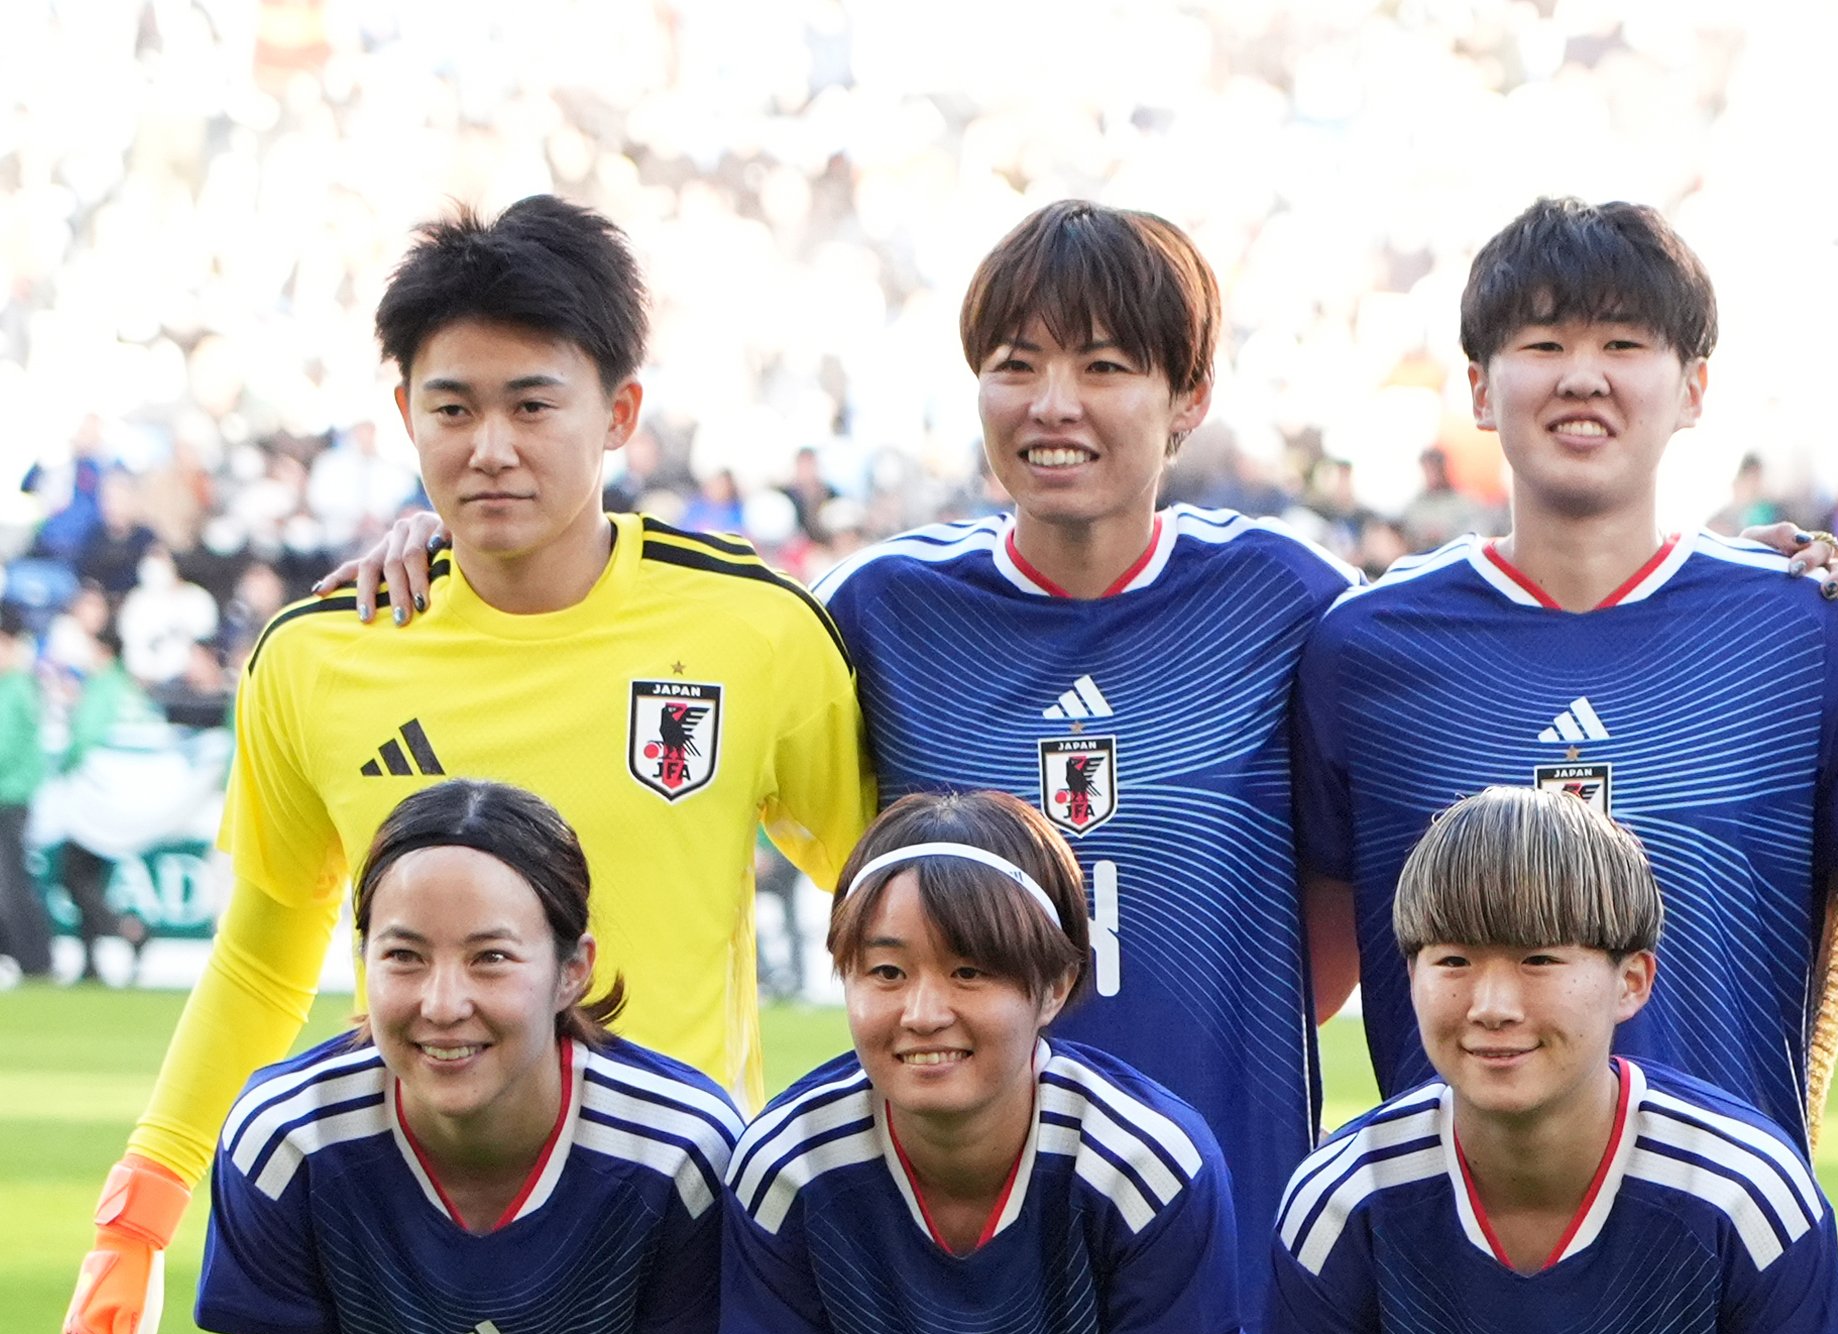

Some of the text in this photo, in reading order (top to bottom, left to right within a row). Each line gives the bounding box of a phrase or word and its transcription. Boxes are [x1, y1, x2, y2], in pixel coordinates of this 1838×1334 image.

[652, 684, 701, 697] JAPAN
[1058, 740, 1097, 751] JAPAN
[652, 762, 691, 781] JFA
[1553, 768, 1593, 779] JAPAN
[1063, 804, 1095, 819] JFA
